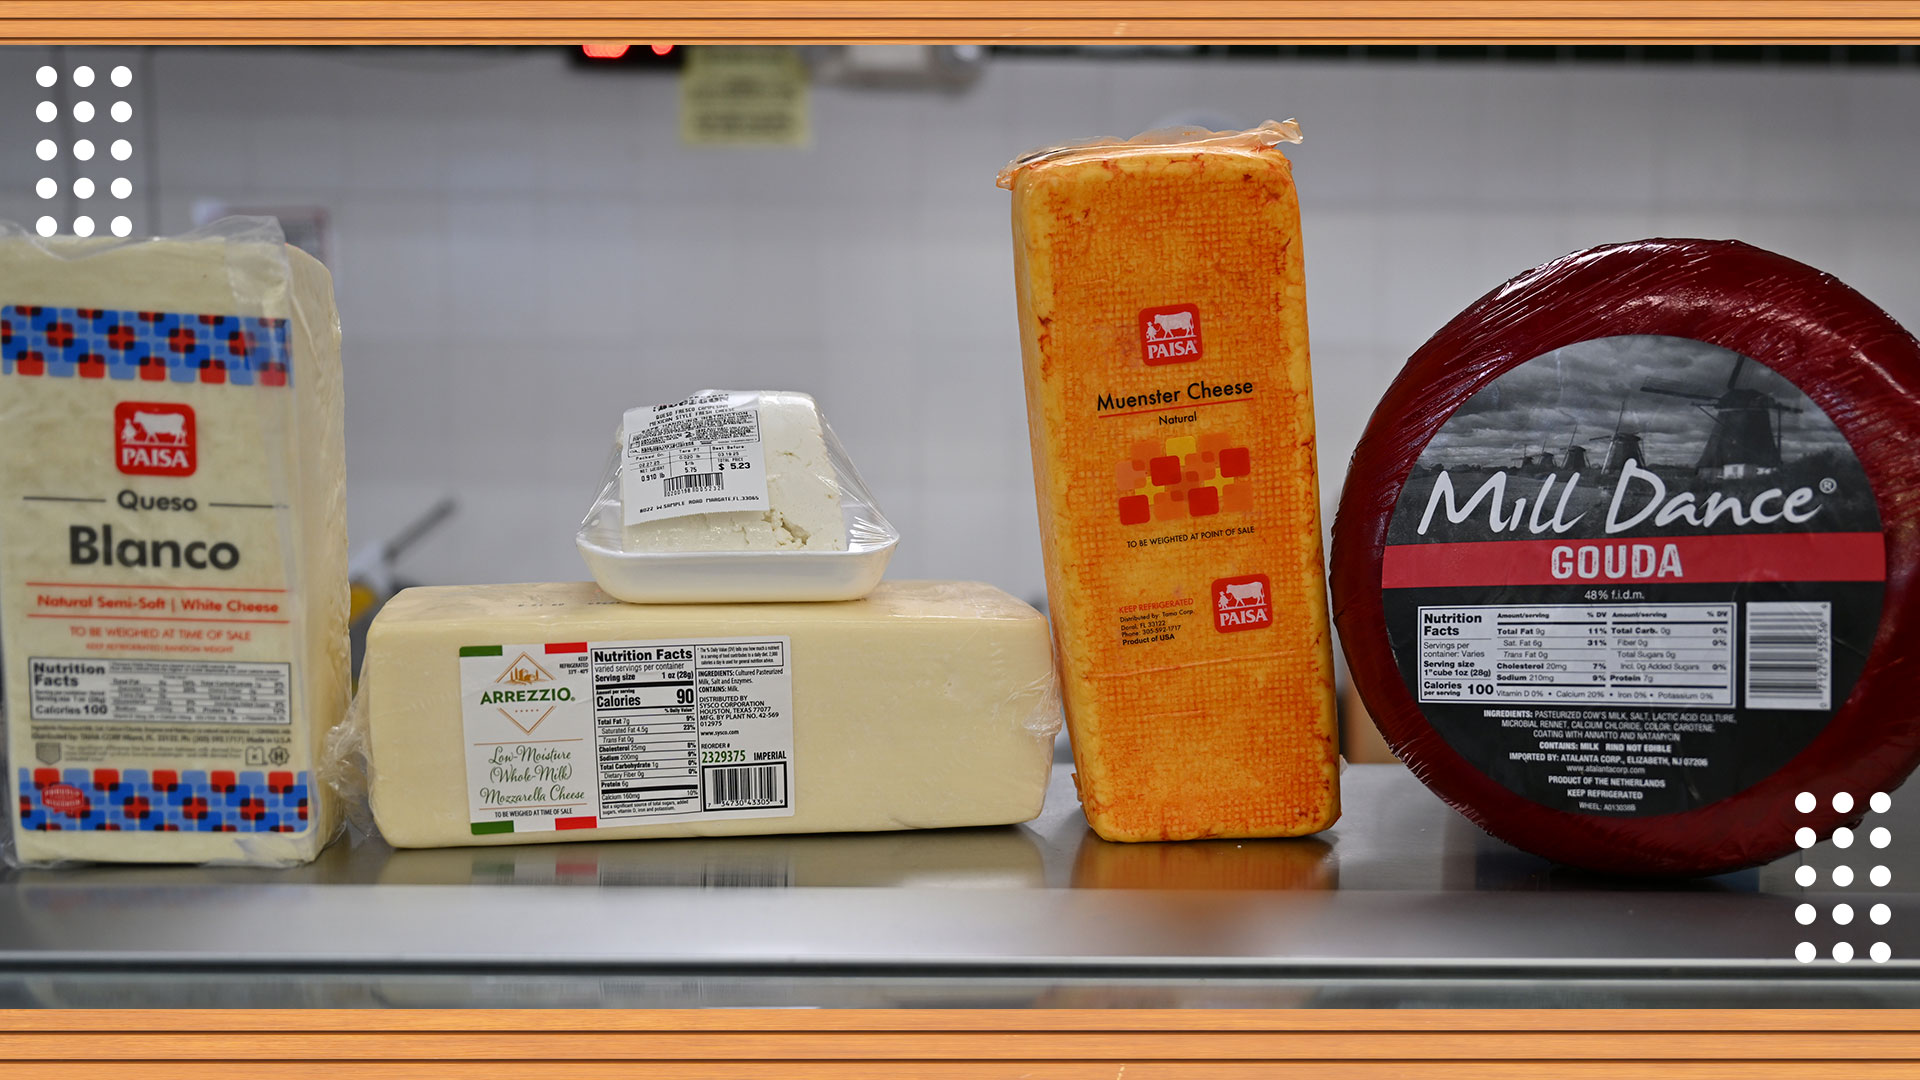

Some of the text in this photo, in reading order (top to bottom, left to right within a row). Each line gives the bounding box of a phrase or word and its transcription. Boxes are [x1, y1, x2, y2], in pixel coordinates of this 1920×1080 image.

[1148, 340, 1198, 360] PAISA
[1097, 380, 1253, 411] Muenster Cheese
[655, 411, 673, 420] QUESO
[1158, 411, 1197, 425] Natural
[122, 448, 189, 468] PAISA
[718, 461, 752, 471] $ 5.23
[116, 489, 198, 513] Queso
[1416, 457, 1823, 536] Mill Dance
[1127, 540, 1138, 548] TO
[1139, 539, 1148, 547] BE
[1149, 534, 1189, 546] WEIGHTED
[1201, 529, 1223, 539] POINT
[1225, 528, 1235, 536] OF
[1237, 526, 1255, 534] SALE
[69, 524, 240, 570] Blanco
[1551, 543, 1684, 579] GOUDA
[1584, 589, 1645, 600] 48% f.i.d.m.
[37, 595, 279, 613] Natural Semi-Soft White Cheese
[1119, 598, 1194, 614] KEEP REFRIGERATED
[1120, 613, 1151, 623] Distributed
[1219, 608, 1268, 627] PAISA
[1423, 613, 1482, 624] Nutrition
[70, 626, 251, 642] TO BE WEIGHED AT TIME OF SALE
[1423, 625, 1460, 636] Facts
[1535, 628, 1546, 636] 9g
[1587, 627, 1607, 635] 11%
[1122, 637, 1150, 646] Product
[1159, 633, 1175, 641] USA
[1423, 642, 1455, 650] Servings
[594, 648, 693, 663] Nutrition Facts
[1423, 650, 1485, 658] container: Varies
[33, 663, 105, 675] Nutrition
[594, 662, 685, 673] varied servings per container
[1423, 660, 1475, 668] Serving size
[1545, 663, 1568, 671] 20mg
[595, 674, 621, 682] Serving
[622, 673, 636, 681] size
[677, 671, 694, 680] (28g)
[698, 667, 784, 677] INGREDIENTS: Cultured Pasteurized
[1455, 669, 1469, 677] 1oz
[1470, 669, 1491, 678] (28g)
[1528, 674, 1555, 682] 210mg
[33, 675, 79, 687] Facts
[1609, 674, 1654, 683] Protein 7g
[1423, 681, 1494, 696] Calories 100
[480, 686, 572, 705] ARREZZIO
[596, 688, 694, 708] Calories 90
[699, 695, 739, 703] DISTRIBUTED
[35, 704, 108, 715] Calories 100
[720, 700, 765, 708] CORPORATION
[699, 707, 732, 715] HOUSTON,
[733, 706, 752, 714] TEXAS
[725, 712, 746, 720] PLANT
[758, 711, 780, 719] 42-569
[623, 718, 631, 726] 7g
[1538, 741, 1672, 753] CONTAINS: MILK RIND NOT EDIBLE
[488, 744, 571, 766] Low-Moisture
[701, 749, 787, 764] 2329375 IMPERIAL
[1509, 752, 1546, 761] IMPORTED
[1547, 753, 1560, 762] BY:
[1560, 753, 1600, 763] ATALANTA
[1626, 756, 1671, 766] ELIZABETH,
[1671, 757, 1683, 766] NJ
[489, 763, 573, 783] (Whole-Milk)
[1548, 775, 1666, 788] PRODUCT OF THE NETHERLANDS
[479, 783, 585, 806] Mozzarella Cheese
[1567, 788, 1644, 800] KEEP REFRIGERATED
[540, 808, 552, 816] TIME
[560, 807, 573, 815] SALE
